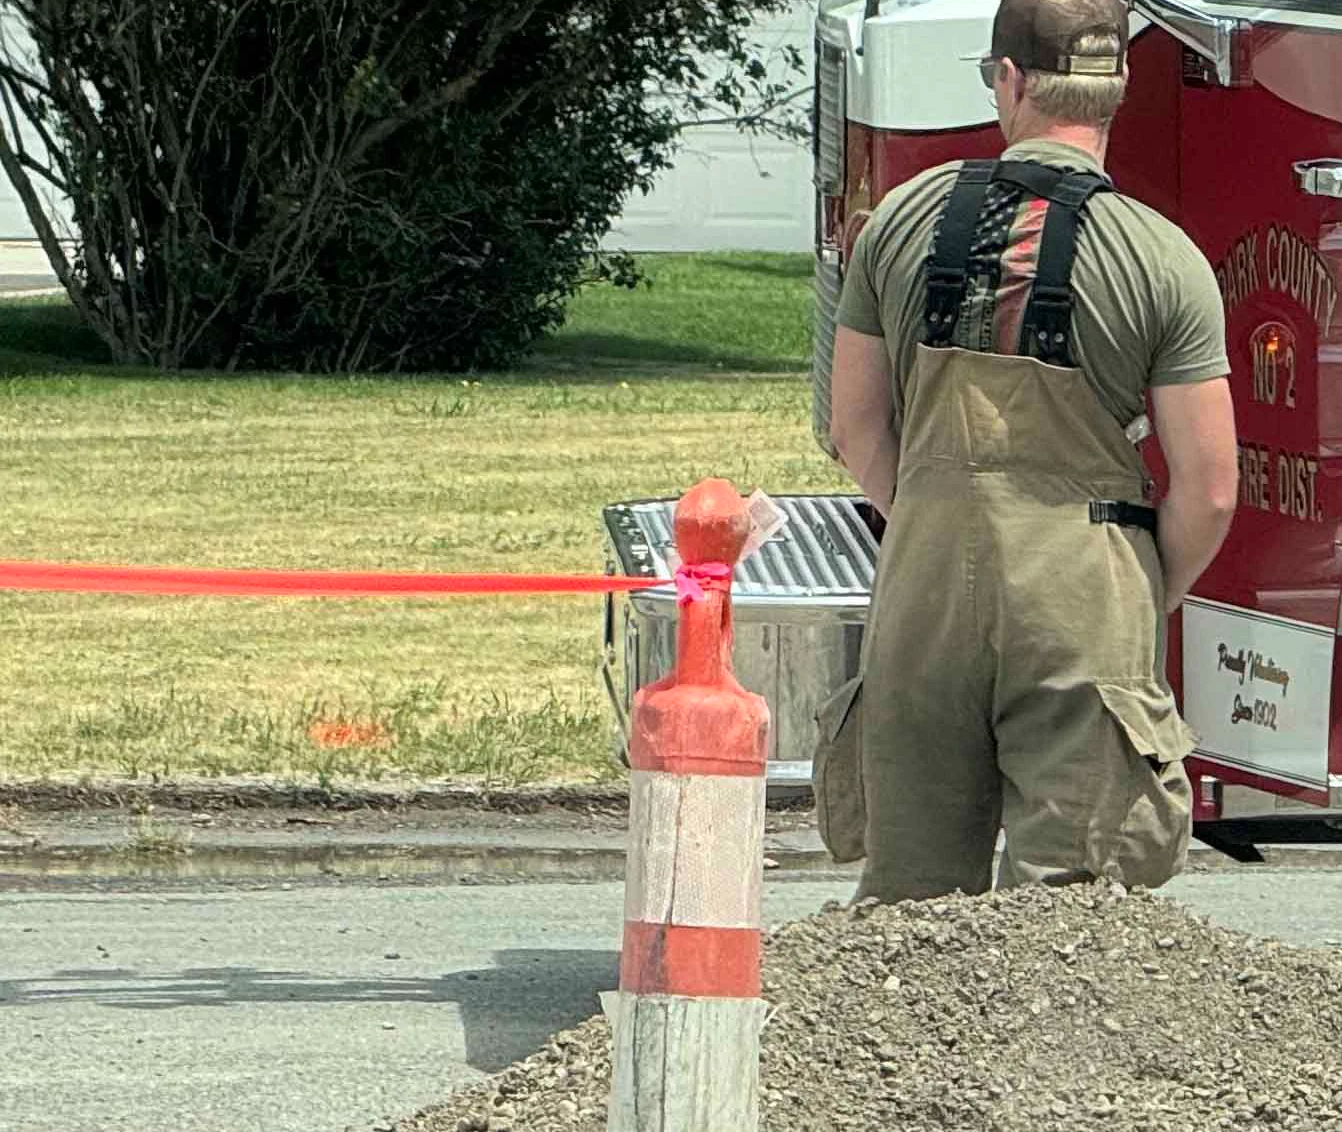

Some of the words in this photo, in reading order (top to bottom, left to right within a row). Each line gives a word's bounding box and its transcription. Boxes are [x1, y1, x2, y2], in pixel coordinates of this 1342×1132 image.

[1265, 221, 1337, 340] COUNTY
[1252, 340, 1276, 405] NO
[1284, 344, 1297, 411] 2
[1278, 448, 1324, 523] DIST.
